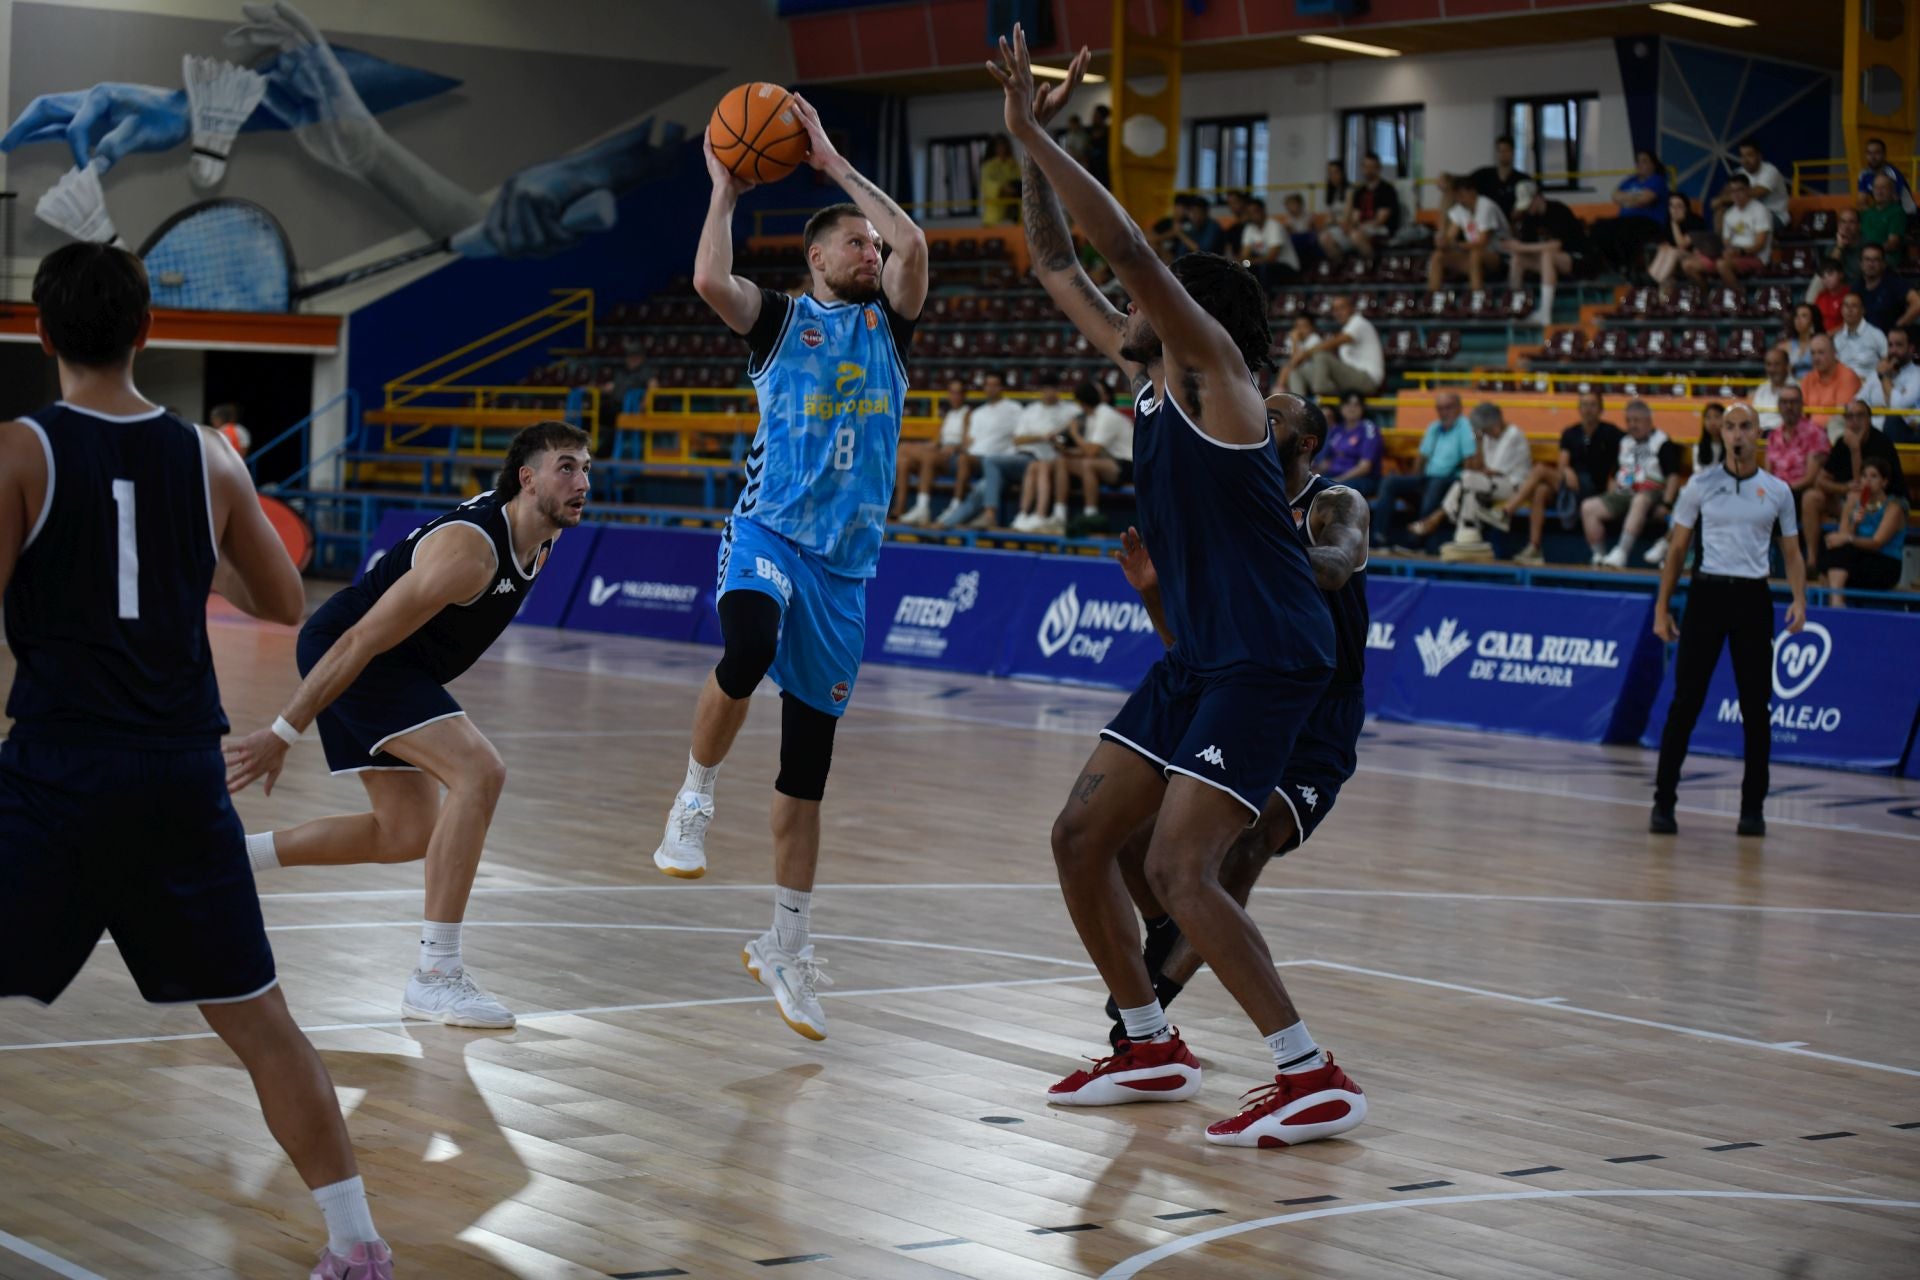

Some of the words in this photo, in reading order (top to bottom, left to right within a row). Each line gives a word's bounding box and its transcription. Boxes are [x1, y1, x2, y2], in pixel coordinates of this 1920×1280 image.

[803, 395, 888, 420] agropal
[834, 428, 855, 470] 8
[112, 478, 140, 619] 1
[893, 595, 957, 628] FITECU
[1069, 633, 1113, 664] Chef
[1477, 631, 1533, 661] CAJA
[1537, 635, 1619, 668] RURAL
[1469, 659, 1494, 680] DE
[1498, 664, 1573, 687] ZAMORA
[1717, 698, 1841, 732] MALEJO
